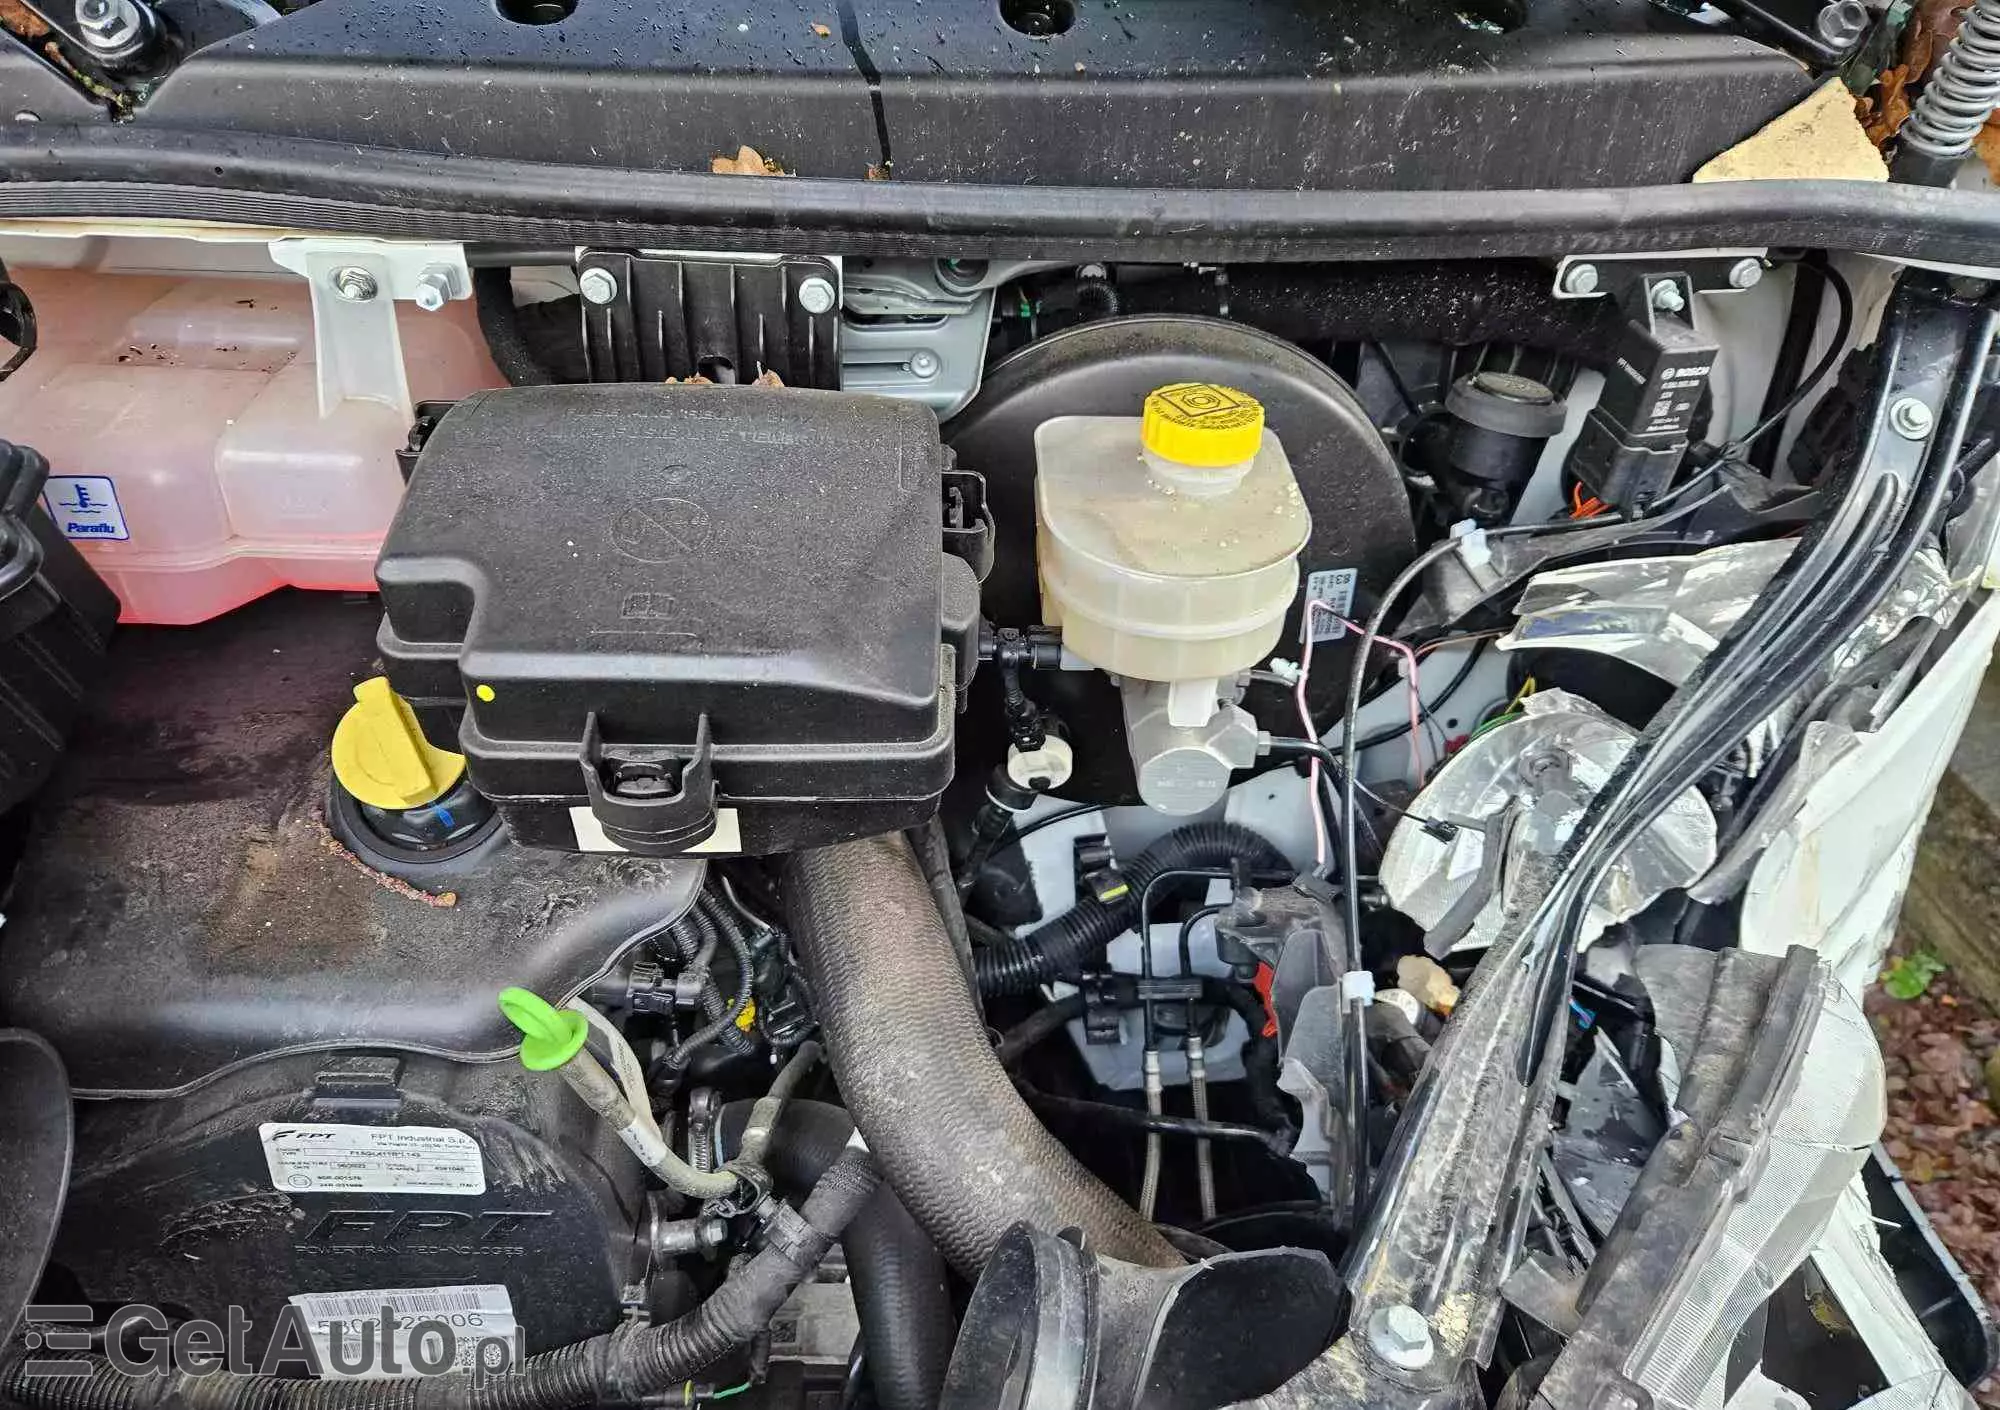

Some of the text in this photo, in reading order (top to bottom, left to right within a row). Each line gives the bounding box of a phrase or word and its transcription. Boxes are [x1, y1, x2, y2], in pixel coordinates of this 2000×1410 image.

[67, 522, 115, 533] Paraflu
[398, 1135, 445, 1143] Industrial
[304, 1210, 554, 1240] FPT
